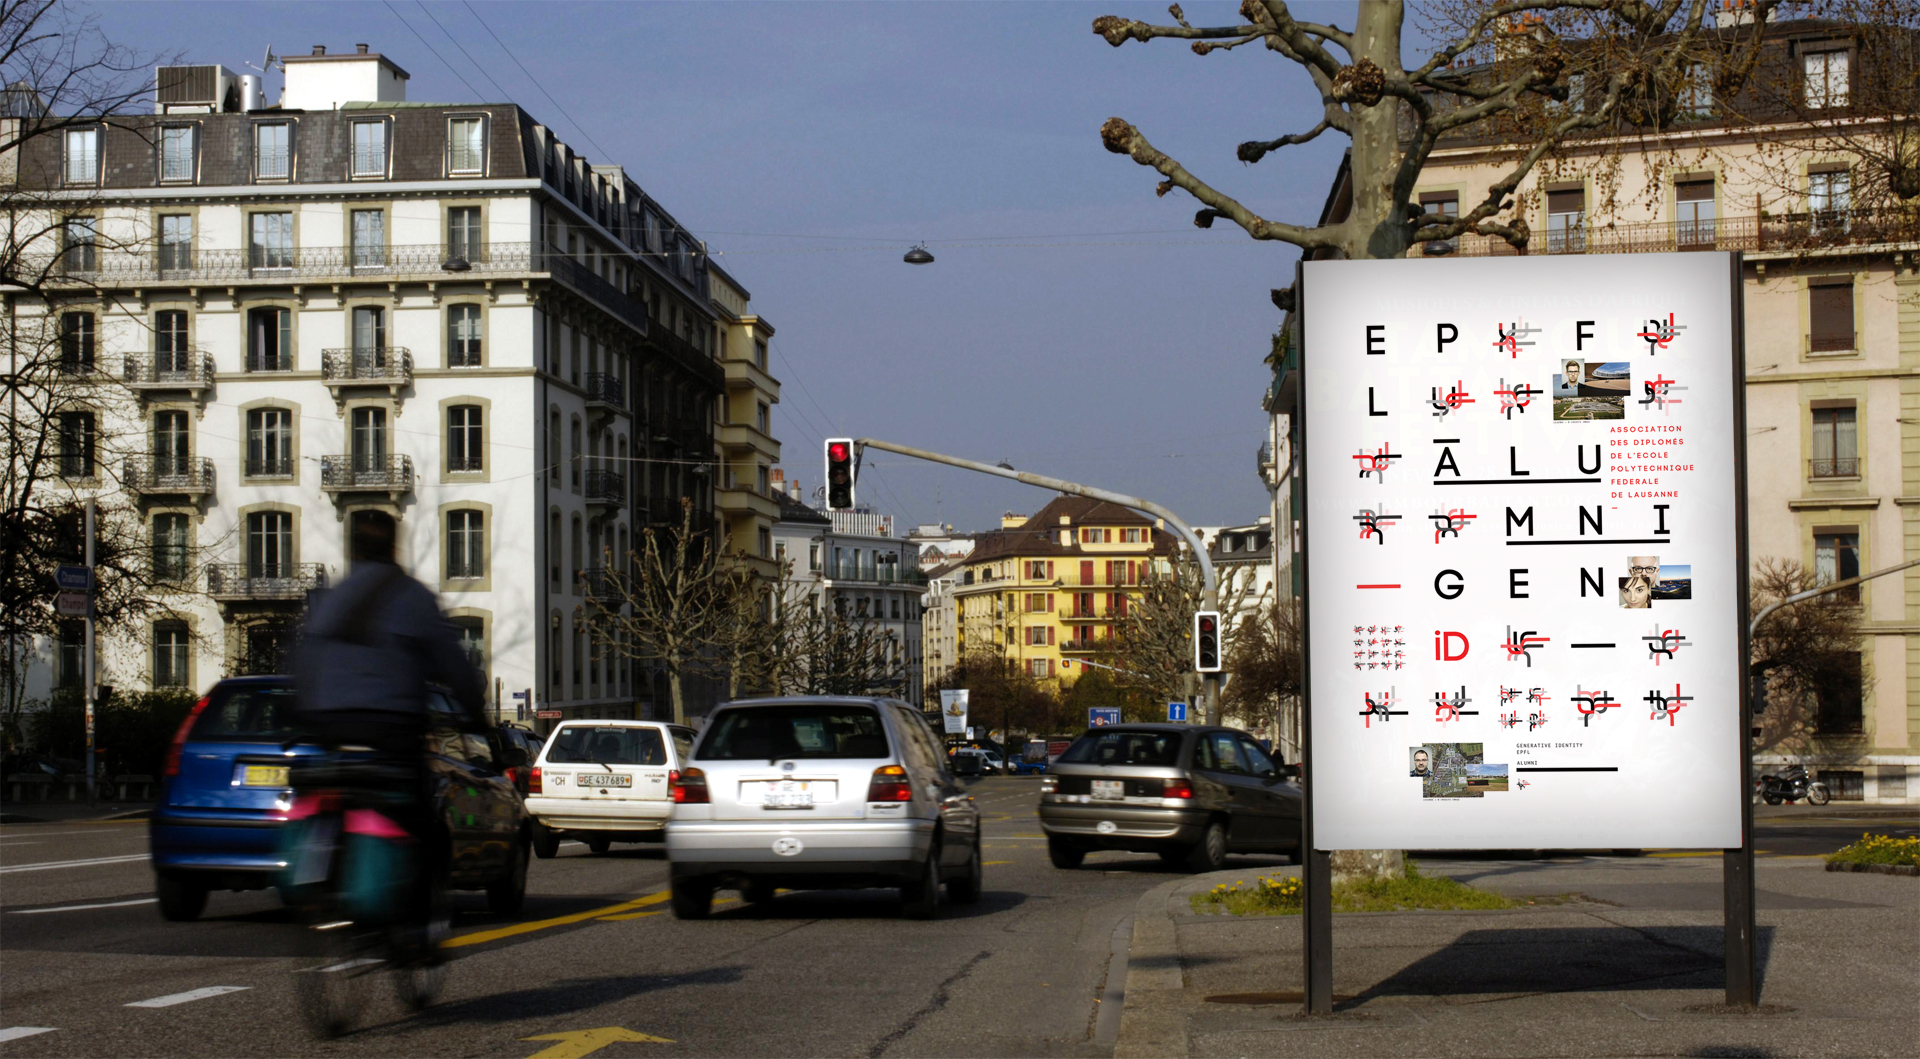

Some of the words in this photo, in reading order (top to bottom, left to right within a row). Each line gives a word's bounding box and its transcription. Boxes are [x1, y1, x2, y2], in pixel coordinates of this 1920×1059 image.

[1366, 325, 1386, 355] E
[1437, 323, 1459, 354] P
[1577, 321, 1596, 351] F
[1369, 387, 1388, 417] L
[1610, 425, 1682, 433] ASSOCIATION
[1633, 437, 1684, 446] DIPLOMÉS
[1627, 451, 1669, 459] L'ECOLE
[1610, 464, 1694, 472] POLYTECHNIQUE
[1628, 490, 1679, 498] LAUSANNE
[555, 776, 566, 786] CH
